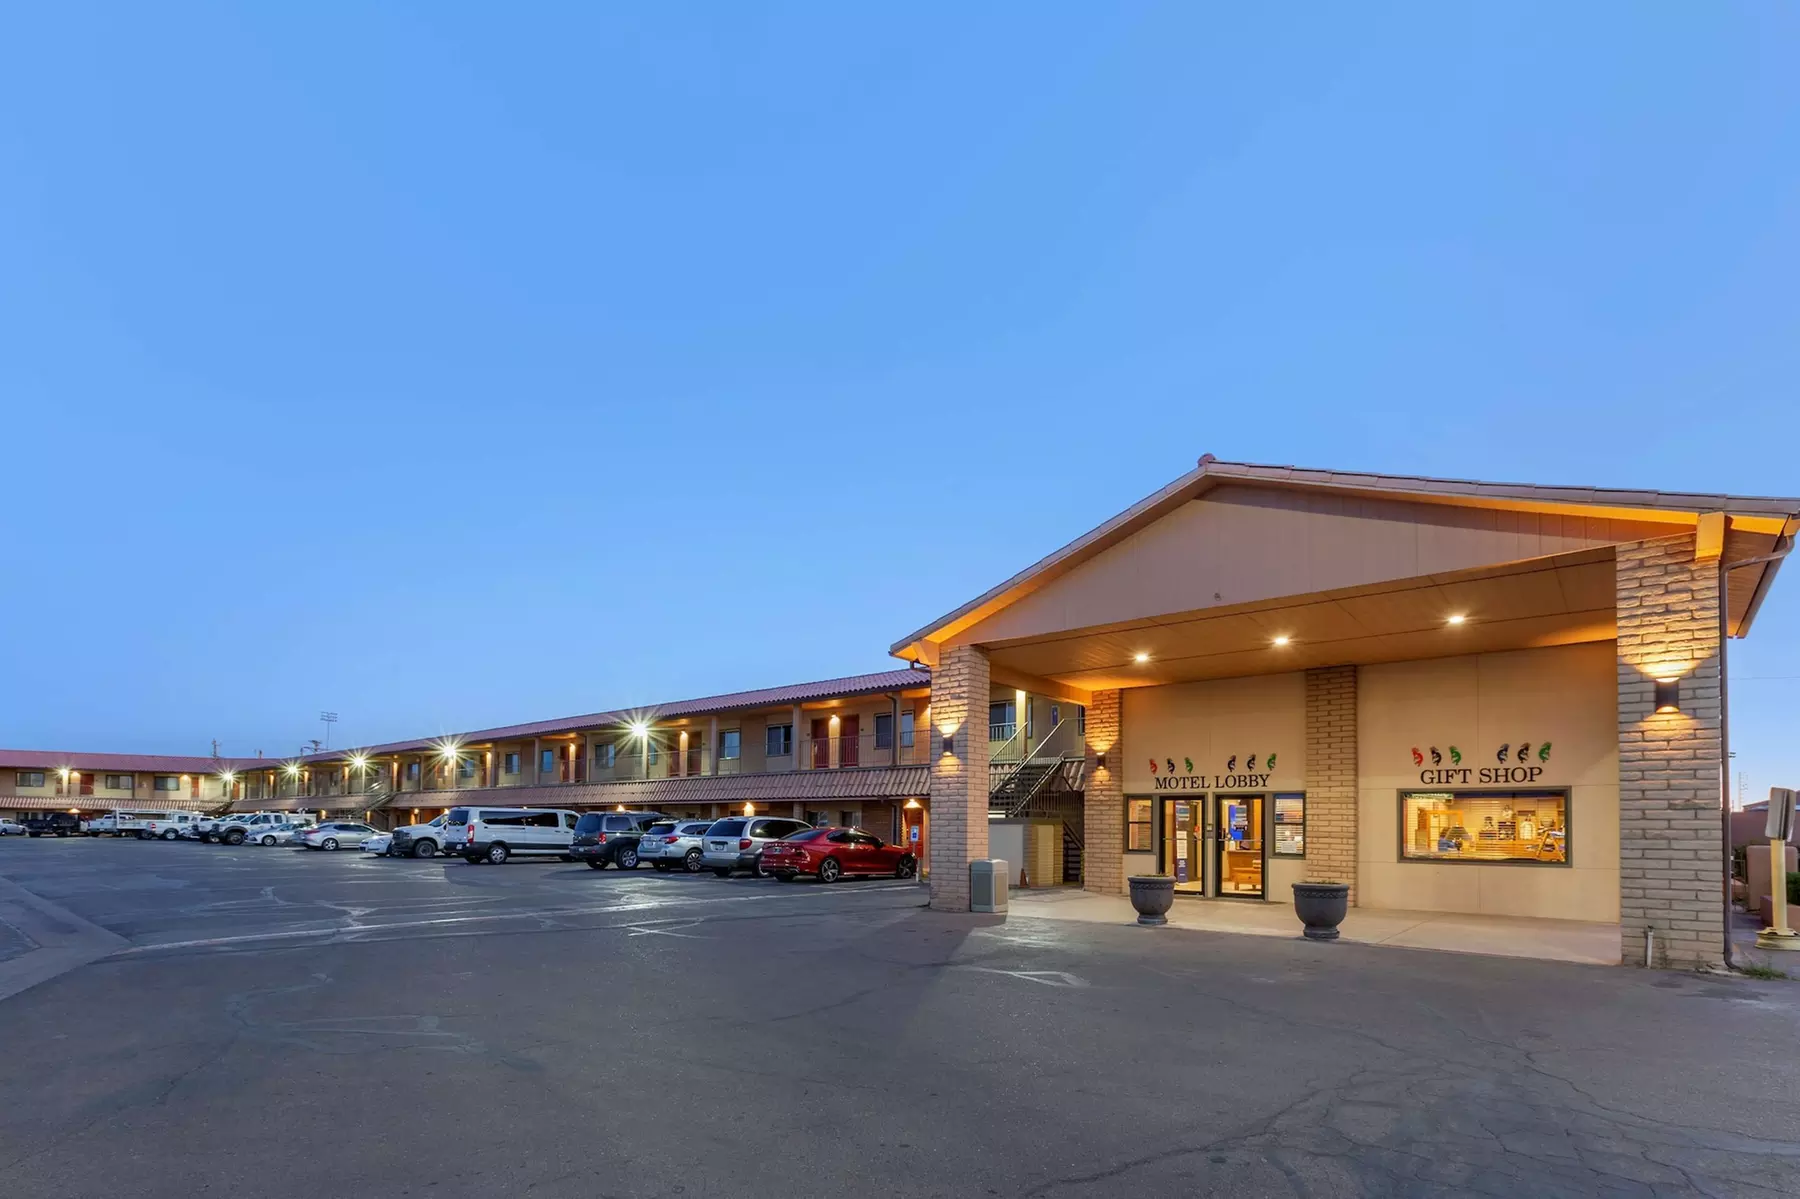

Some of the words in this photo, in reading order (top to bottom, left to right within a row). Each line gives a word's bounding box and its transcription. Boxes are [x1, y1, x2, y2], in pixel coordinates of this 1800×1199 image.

[1155, 776, 1210, 789] MOTEL
[1215, 774, 1270, 788] LOBBY
[1420, 769, 1472, 784] GIFT
[1479, 767, 1543, 783] SHOP
